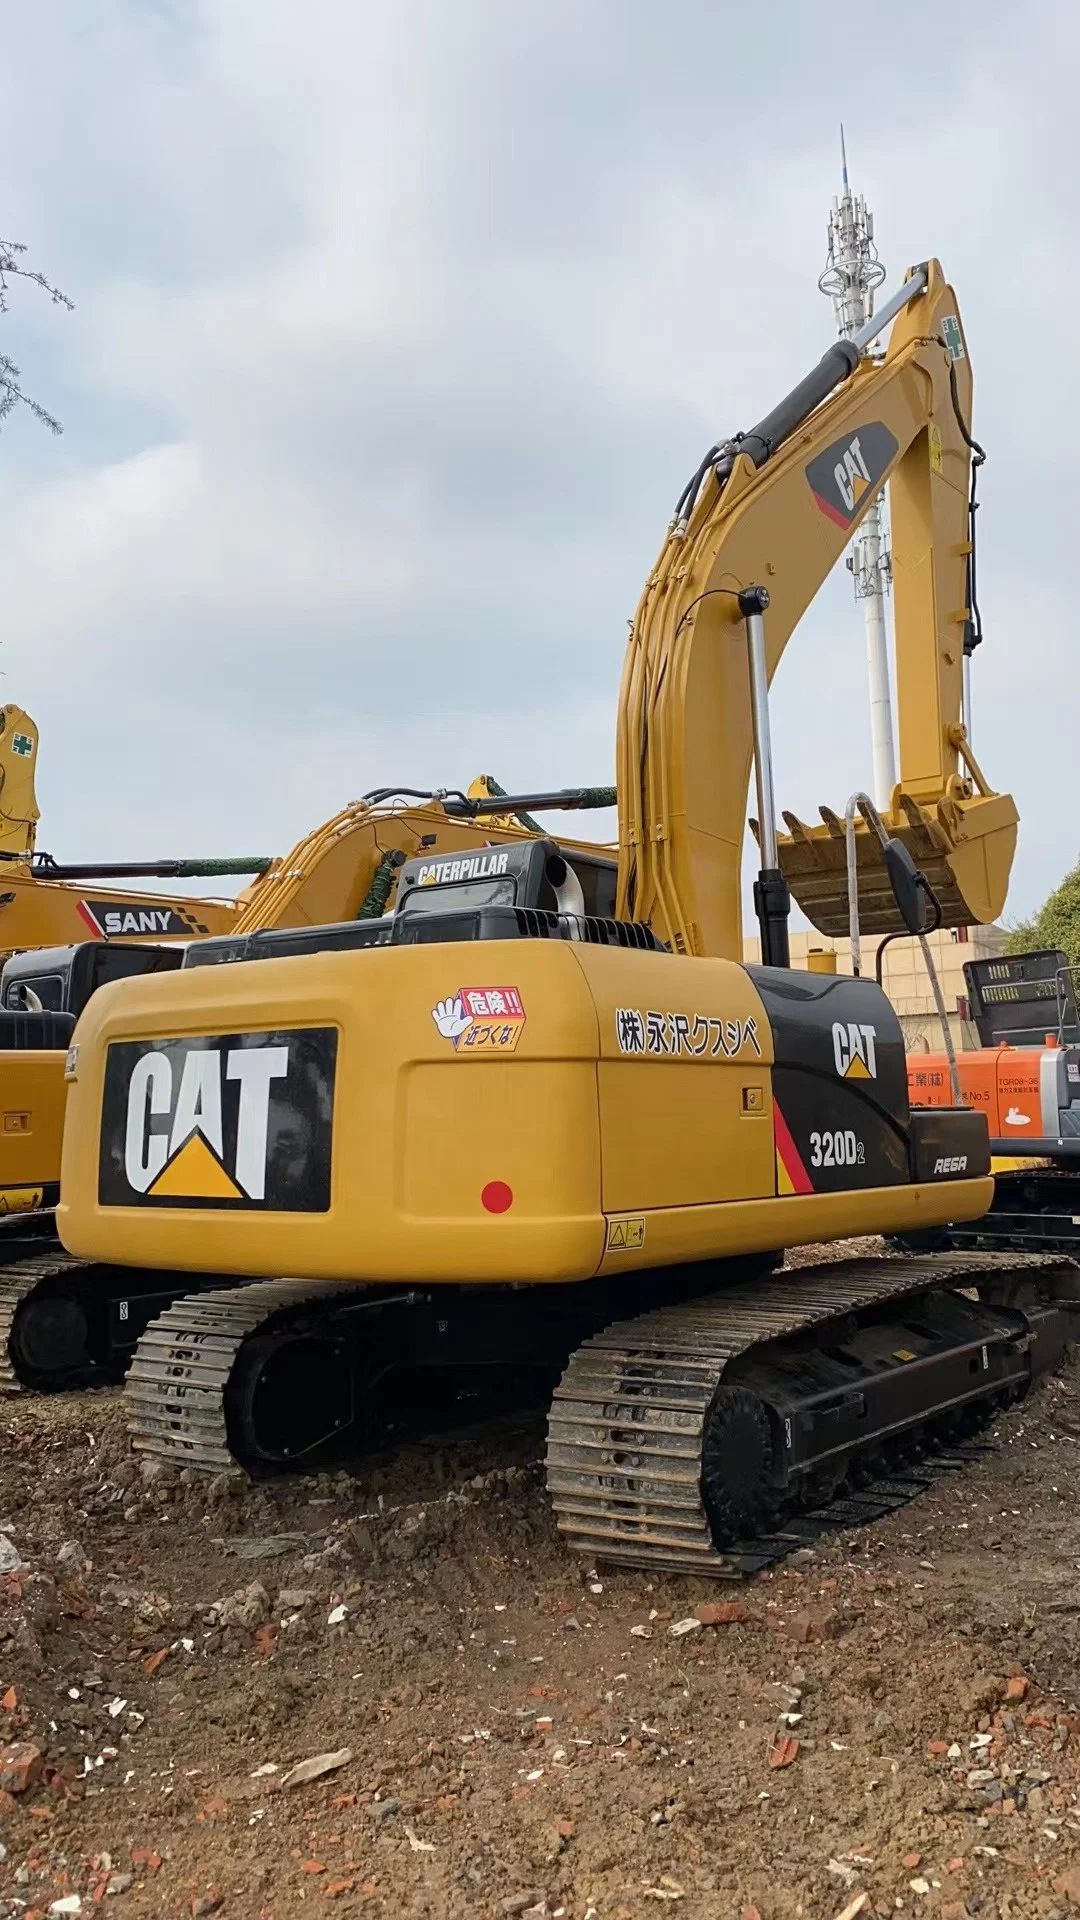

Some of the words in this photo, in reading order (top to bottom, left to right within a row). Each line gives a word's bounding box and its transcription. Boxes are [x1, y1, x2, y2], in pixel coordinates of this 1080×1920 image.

[834, 436, 871, 511] CAT
[418, 853, 509, 885] CATERPILLAR
[104, 911, 171, 933] SANY
[466, 991, 521, 1015] 危険!!
[832, 1022, 877, 1079] CAT
[125, 1046, 289, 1200] CAT
